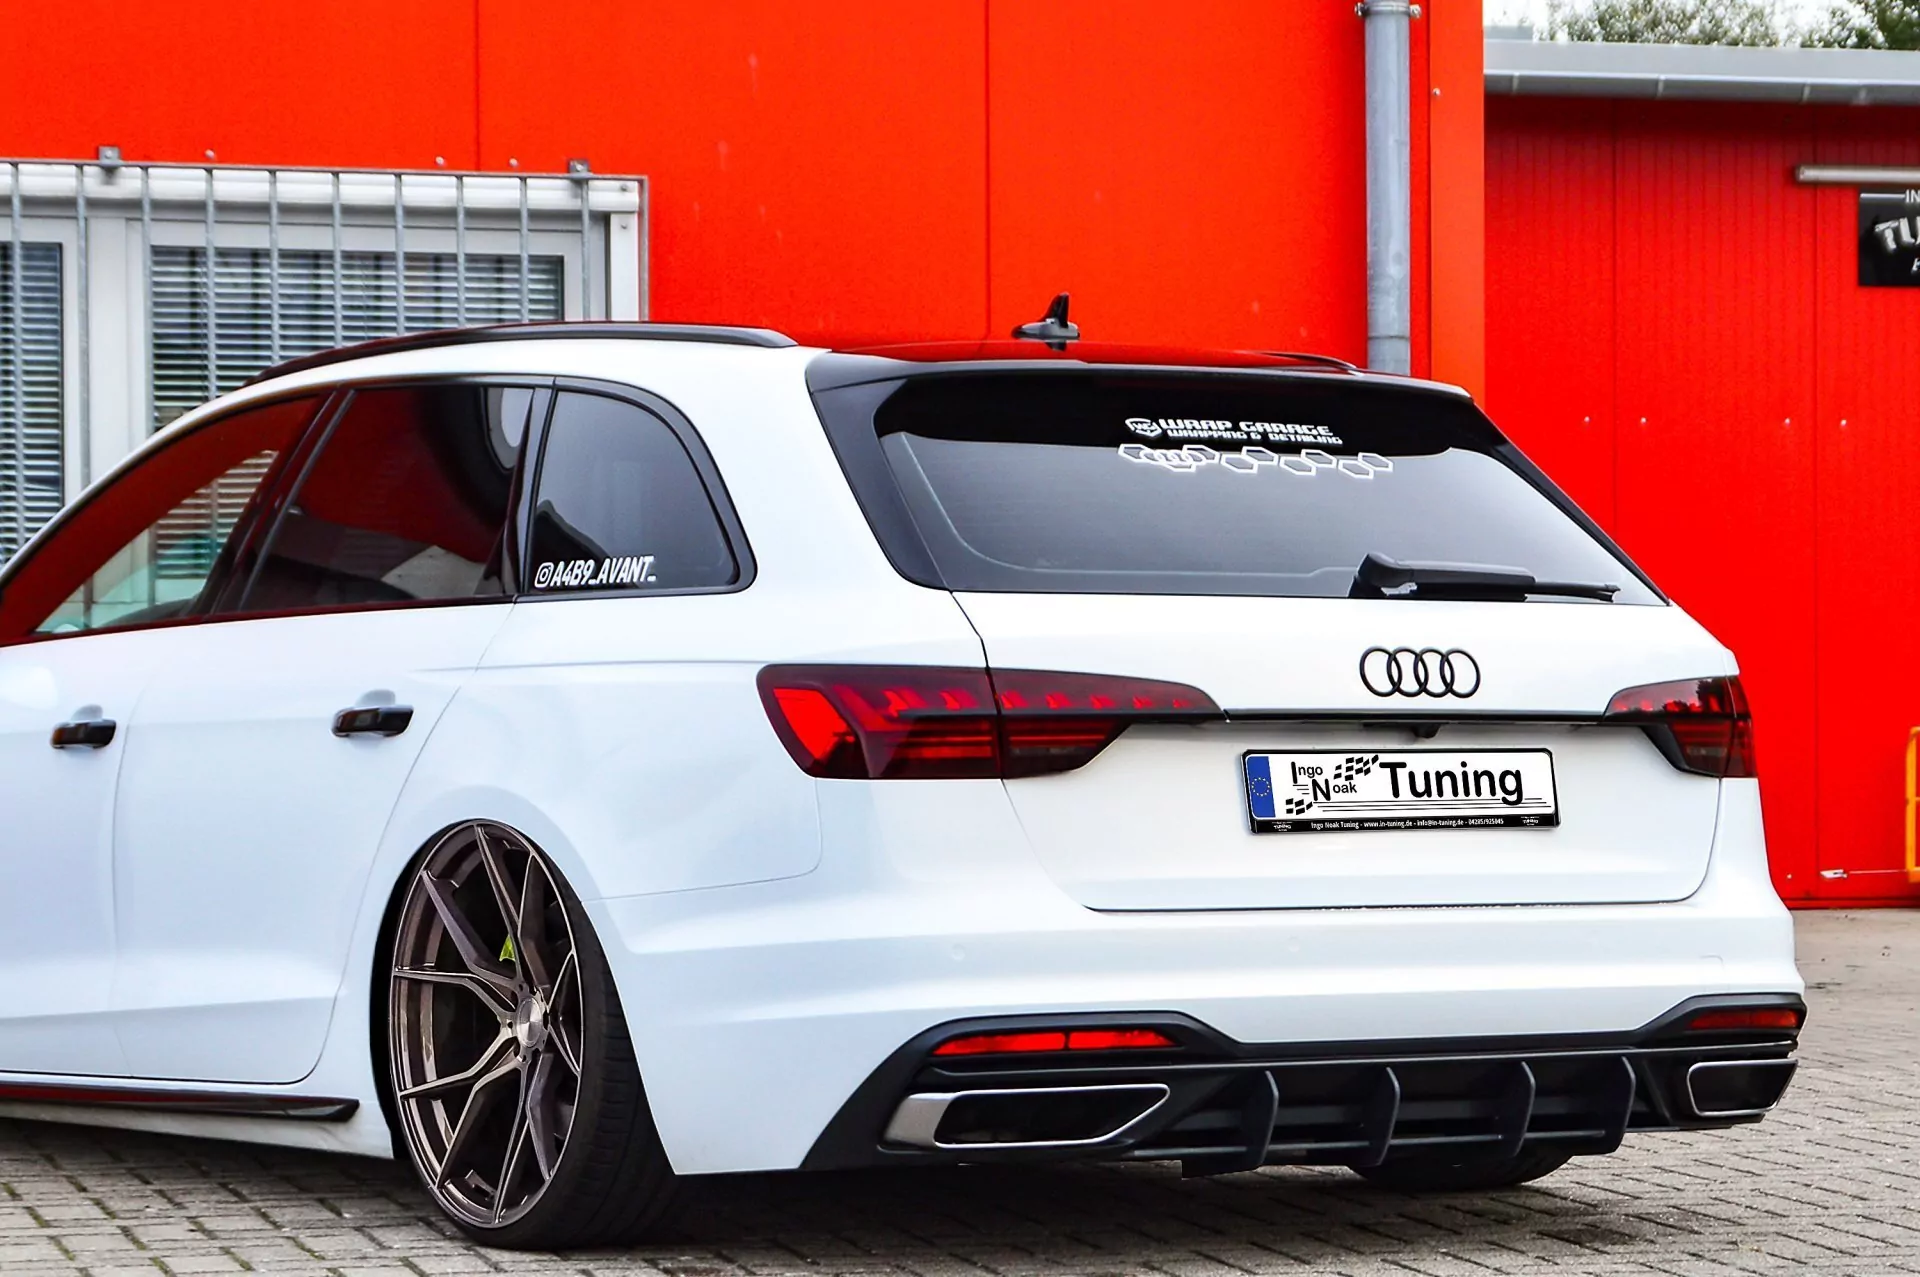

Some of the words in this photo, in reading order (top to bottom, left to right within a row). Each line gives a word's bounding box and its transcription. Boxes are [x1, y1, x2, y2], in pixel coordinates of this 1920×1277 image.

[1158, 418, 1233, 430] WRAP
[1239, 421, 1334, 437] GARAGE
[1166, 429, 1248, 440] WRAPPING
[1268, 433, 1344, 445] DETAILING
[1290, 761, 1324, 785] Ingo
[1378, 760, 1525, 806] Tuning
[1311, 778, 1358, 801] Noak
[1310, 821, 1324, 831] Ingo
[1325, 821, 1340, 829] Noak
[1340, 820, 1360, 830] Tuning
[1363, 819, 1413, 829] www.in-tuning.de
[1416, 818, 1464, 828] info@in-tuning.de
